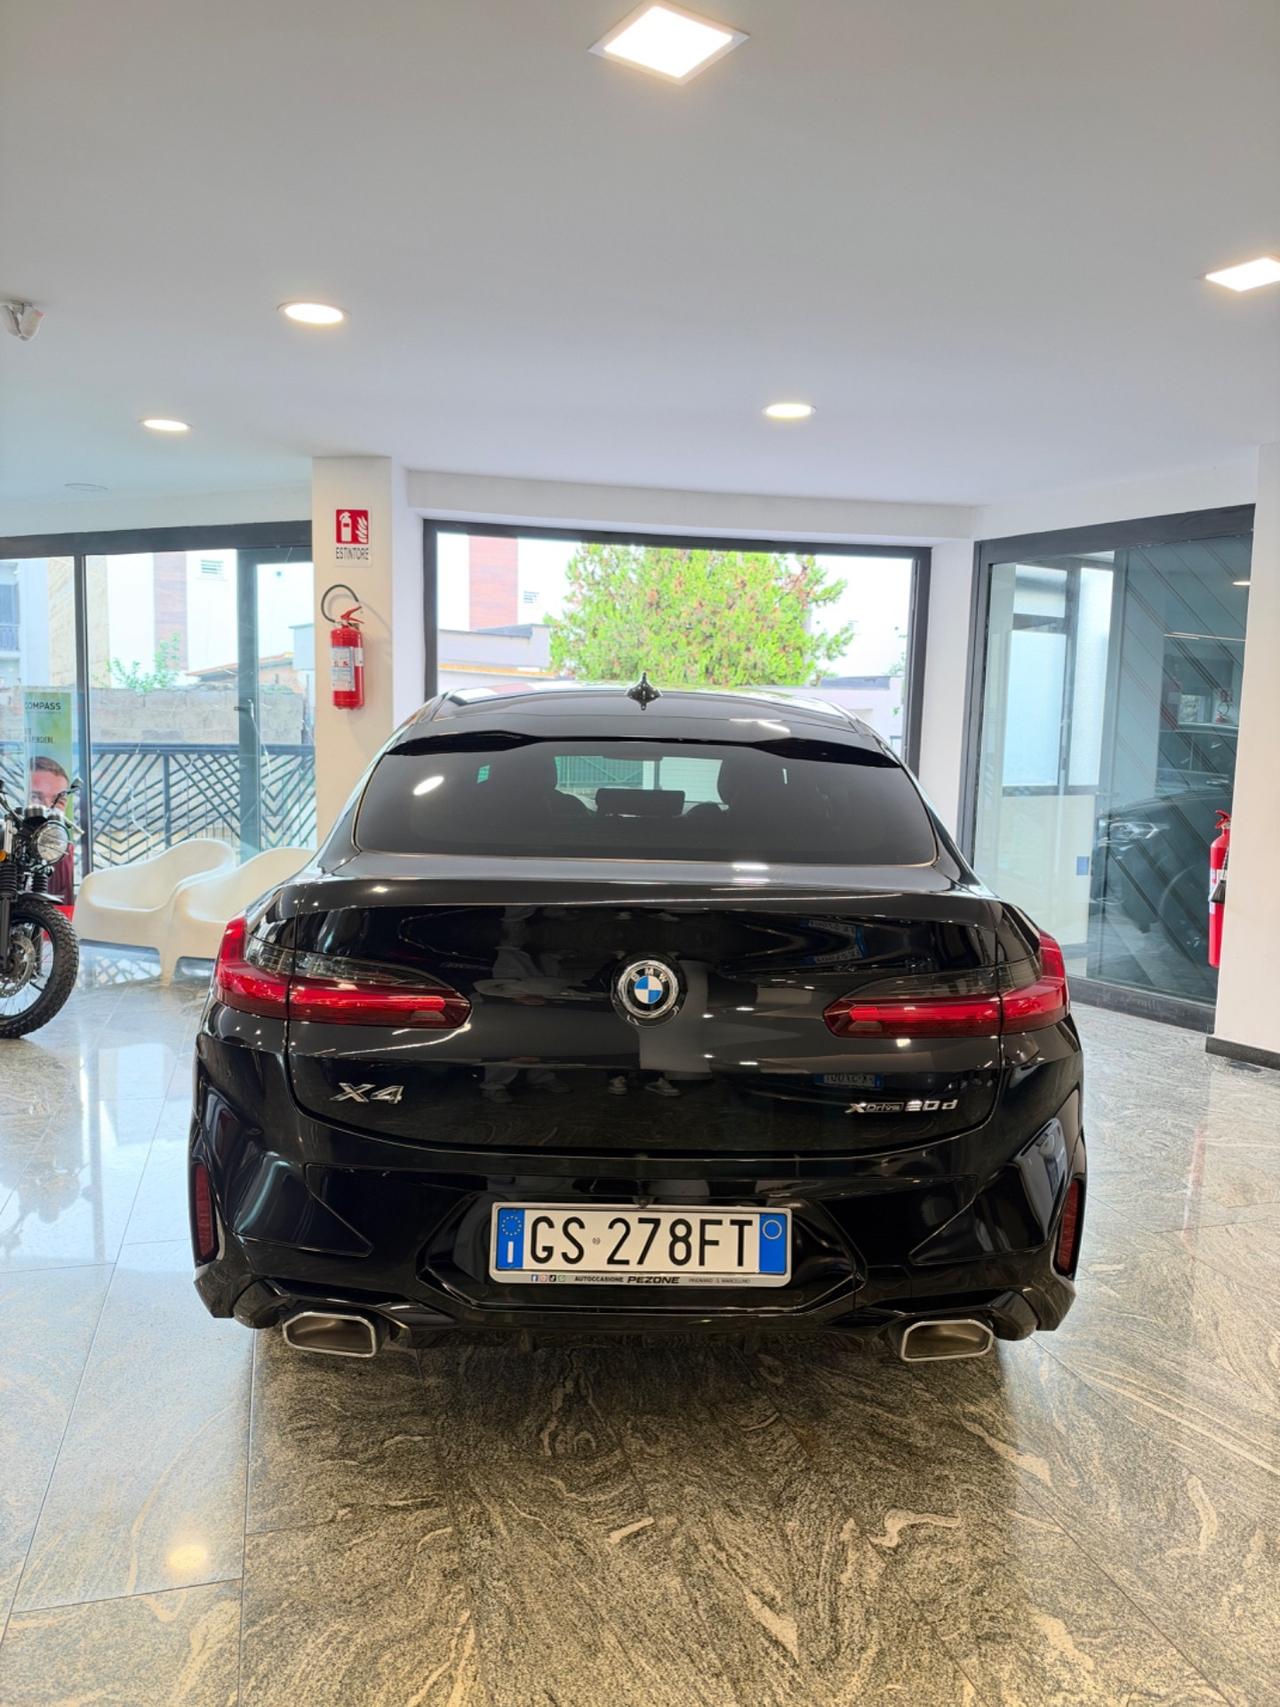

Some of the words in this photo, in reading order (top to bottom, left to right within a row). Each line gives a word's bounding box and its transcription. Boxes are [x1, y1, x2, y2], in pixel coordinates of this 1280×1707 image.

[336, 547, 369, 560] ESTINTORE
[631, 967, 669, 983] BMW
[329, 1082, 404, 1104] X4
[627, 1276, 680, 1284] PEZONE
